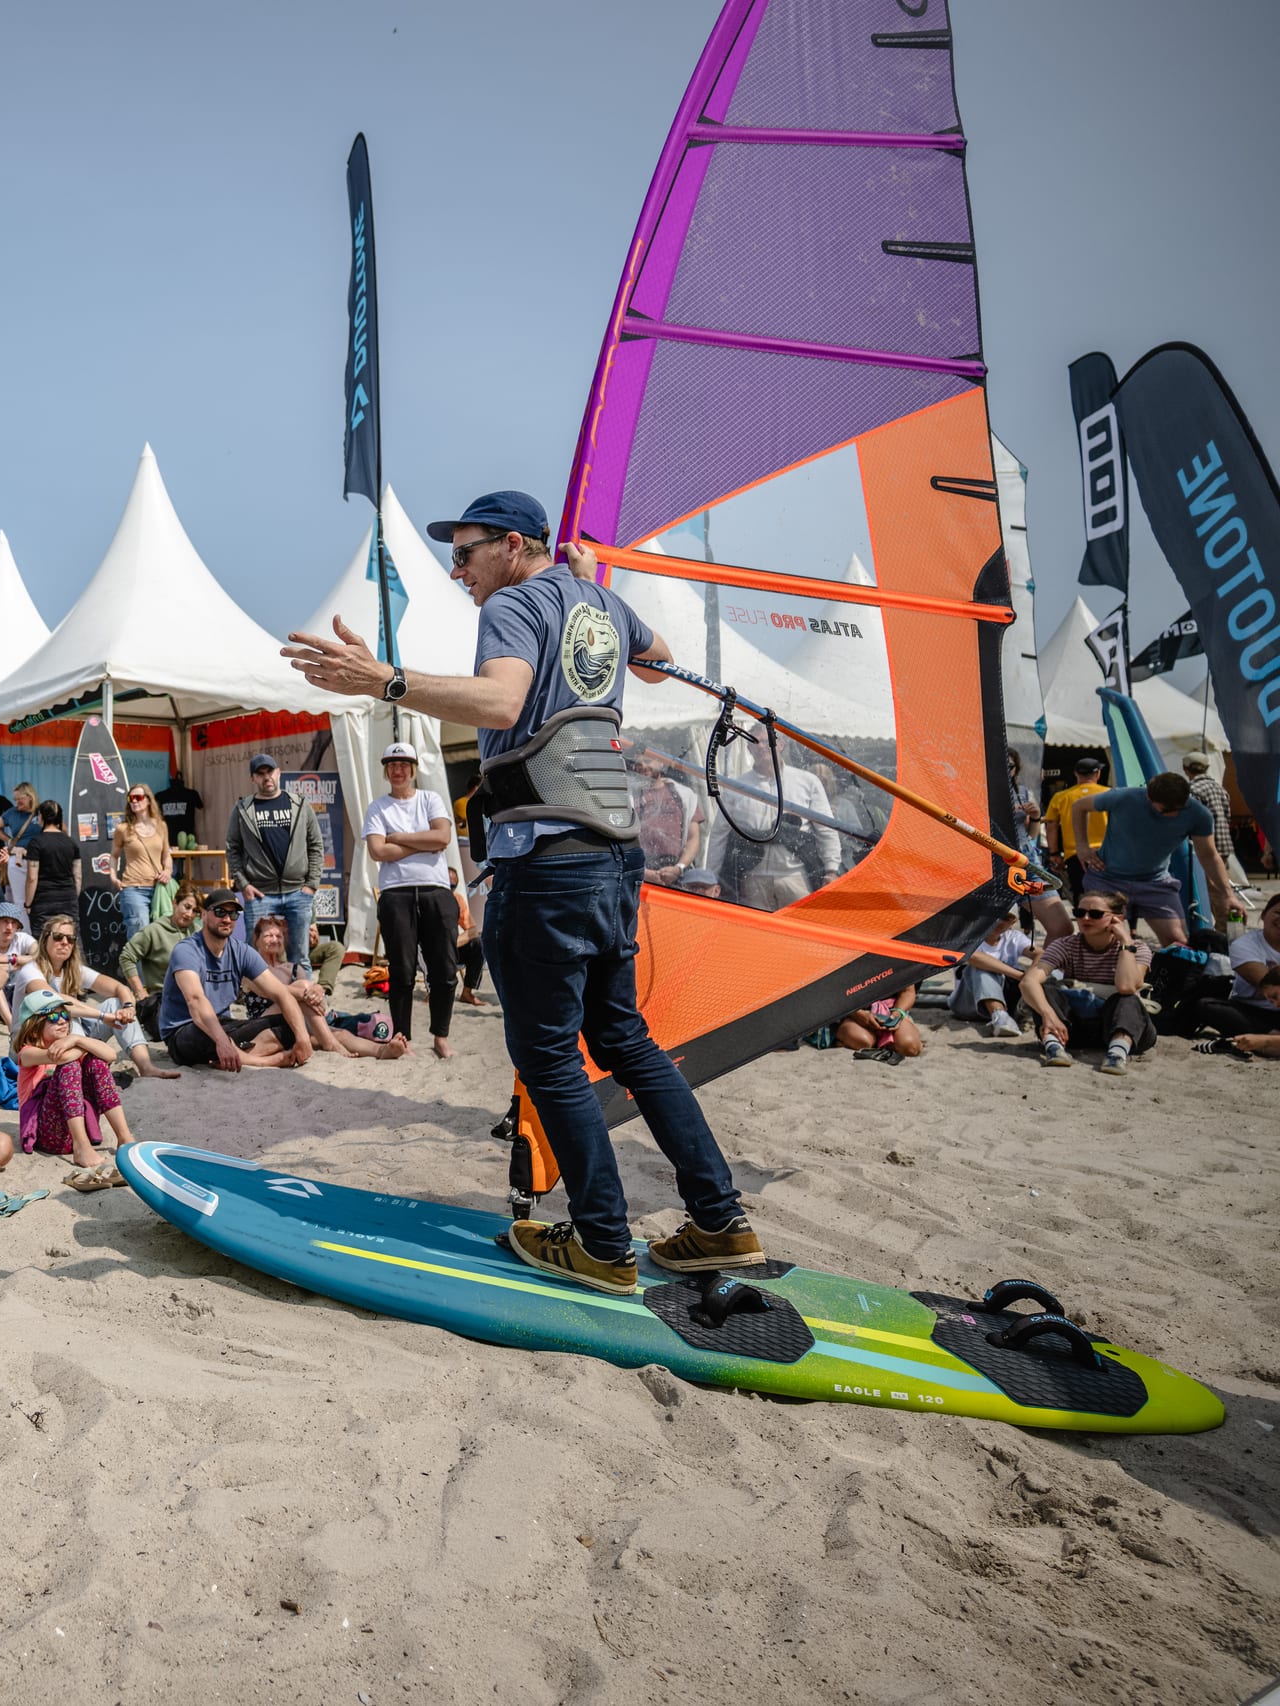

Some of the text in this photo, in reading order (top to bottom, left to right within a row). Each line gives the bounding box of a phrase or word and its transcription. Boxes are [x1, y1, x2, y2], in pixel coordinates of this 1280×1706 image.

[631, 659, 724, 691] EILPRYDE
[124, 758, 166, 770] RAINING
[317, 780, 337, 795] NOT
[256, 809, 291, 821] MP DAV
[84, 890, 121, 917] YOG
[845, 967, 894, 997] NEILPRYDE
[834, 1384, 881, 1397] EAGLE
[917, 1394, 945, 1405] 120
